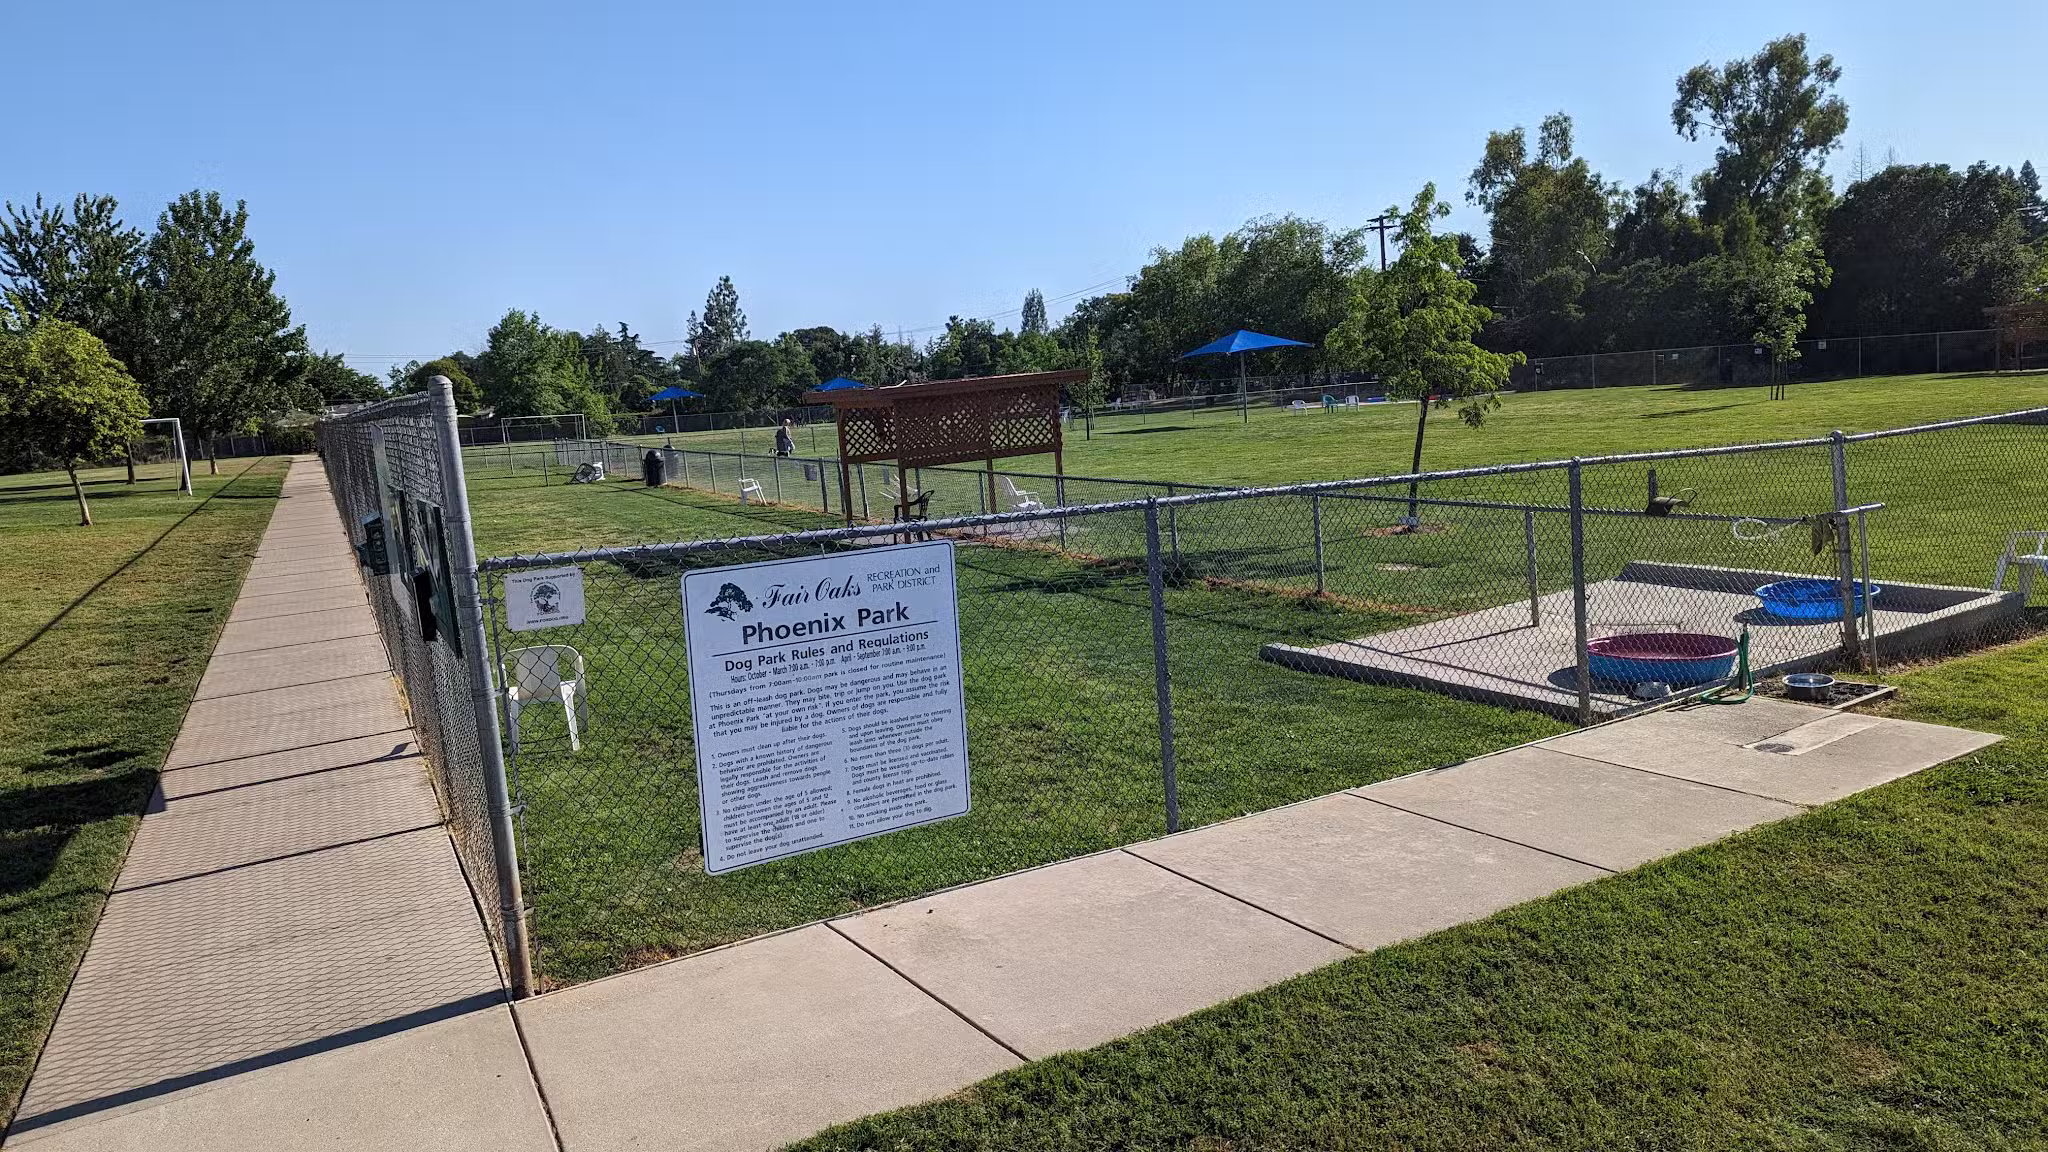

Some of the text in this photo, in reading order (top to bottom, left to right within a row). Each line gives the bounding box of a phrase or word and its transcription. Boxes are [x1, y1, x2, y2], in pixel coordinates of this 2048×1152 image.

[762, 575, 861, 608] Fair Oaks
[866, 563, 940, 582] RECREATION and
[872, 575, 936, 593] PARK DISTRICT
[742, 601, 910, 645] Phoenix Park
[725, 631, 929, 672] Dog Park Rules and Regulations
[709, 687, 747, 699] (Thursdays
[823, 671, 838, 679] park
[847, 665, 868, 674] closed
[881, 660, 904, 668] routine
[711, 706, 755, 720] unpredictable
[757, 702, 782, 712] manner.
[855, 686, 871, 695] jump
[882, 682, 895, 690] you.
[933, 672, 946, 681] park
[743, 694, 773, 706] off-leash
[774, 692, 787, 700] dog
[789, 689, 804, 699] park.
[807, 686, 823, 694] Dogs
[849, 676, 881, 686] dangerous
[882, 672, 894, 680] and
[909, 668, 931, 676] behave
[713, 729, 727, 737] that
[729, 727, 742, 736] you
[770, 716, 793, 727] injured
[794, 715, 802, 723] by
[810, 711, 824, 719] dog.
[826, 706, 850, 715] Owners
[851, 703, 858, 711] of
[888, 693, 920, 704] responsible
[922, 690, 933, 698] and
[718, 718, 744, 727] Phoenix
[746, 714, 760, 722] Park
[774, 709, 789, 718] your
[791, 706, 806, 714] own
[825, 700, 830, 708] If
[832, 699, 844, 708] you
[875, 691, 891, 699] park,
[892, 688, 904, 697] you
[905, 684, 927, 693] assume
[781, 725, 798, 733] liable
[824, 715, 846, 724] actions
[847, 712, 854, 720] of
